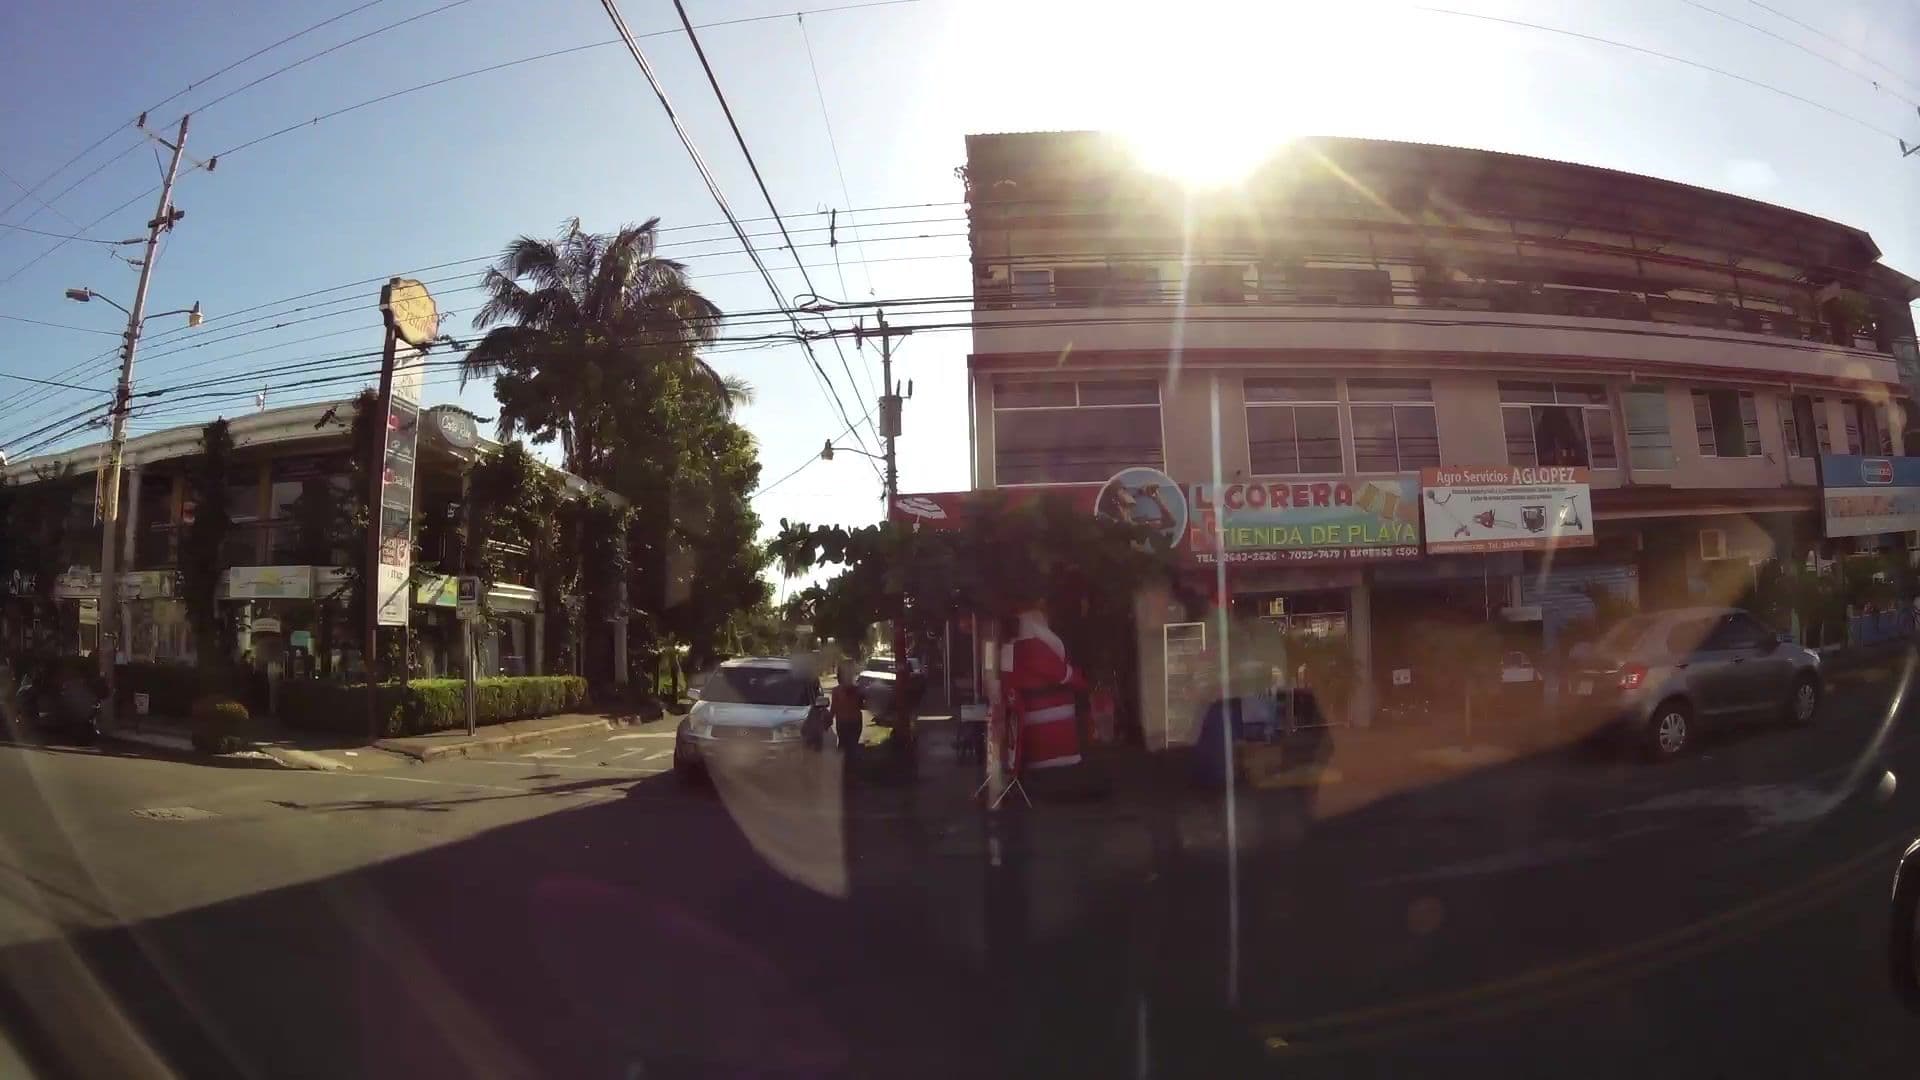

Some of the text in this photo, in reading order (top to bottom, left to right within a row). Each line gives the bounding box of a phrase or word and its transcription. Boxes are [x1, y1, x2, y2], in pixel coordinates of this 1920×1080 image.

[1436, 467, 1576, 486] Agro Servicios AGLOPEZ
[1194, 483, 1354, 510] LCORERA
[1216, 523, 1416, 546] TIENDA DE PLAYA
